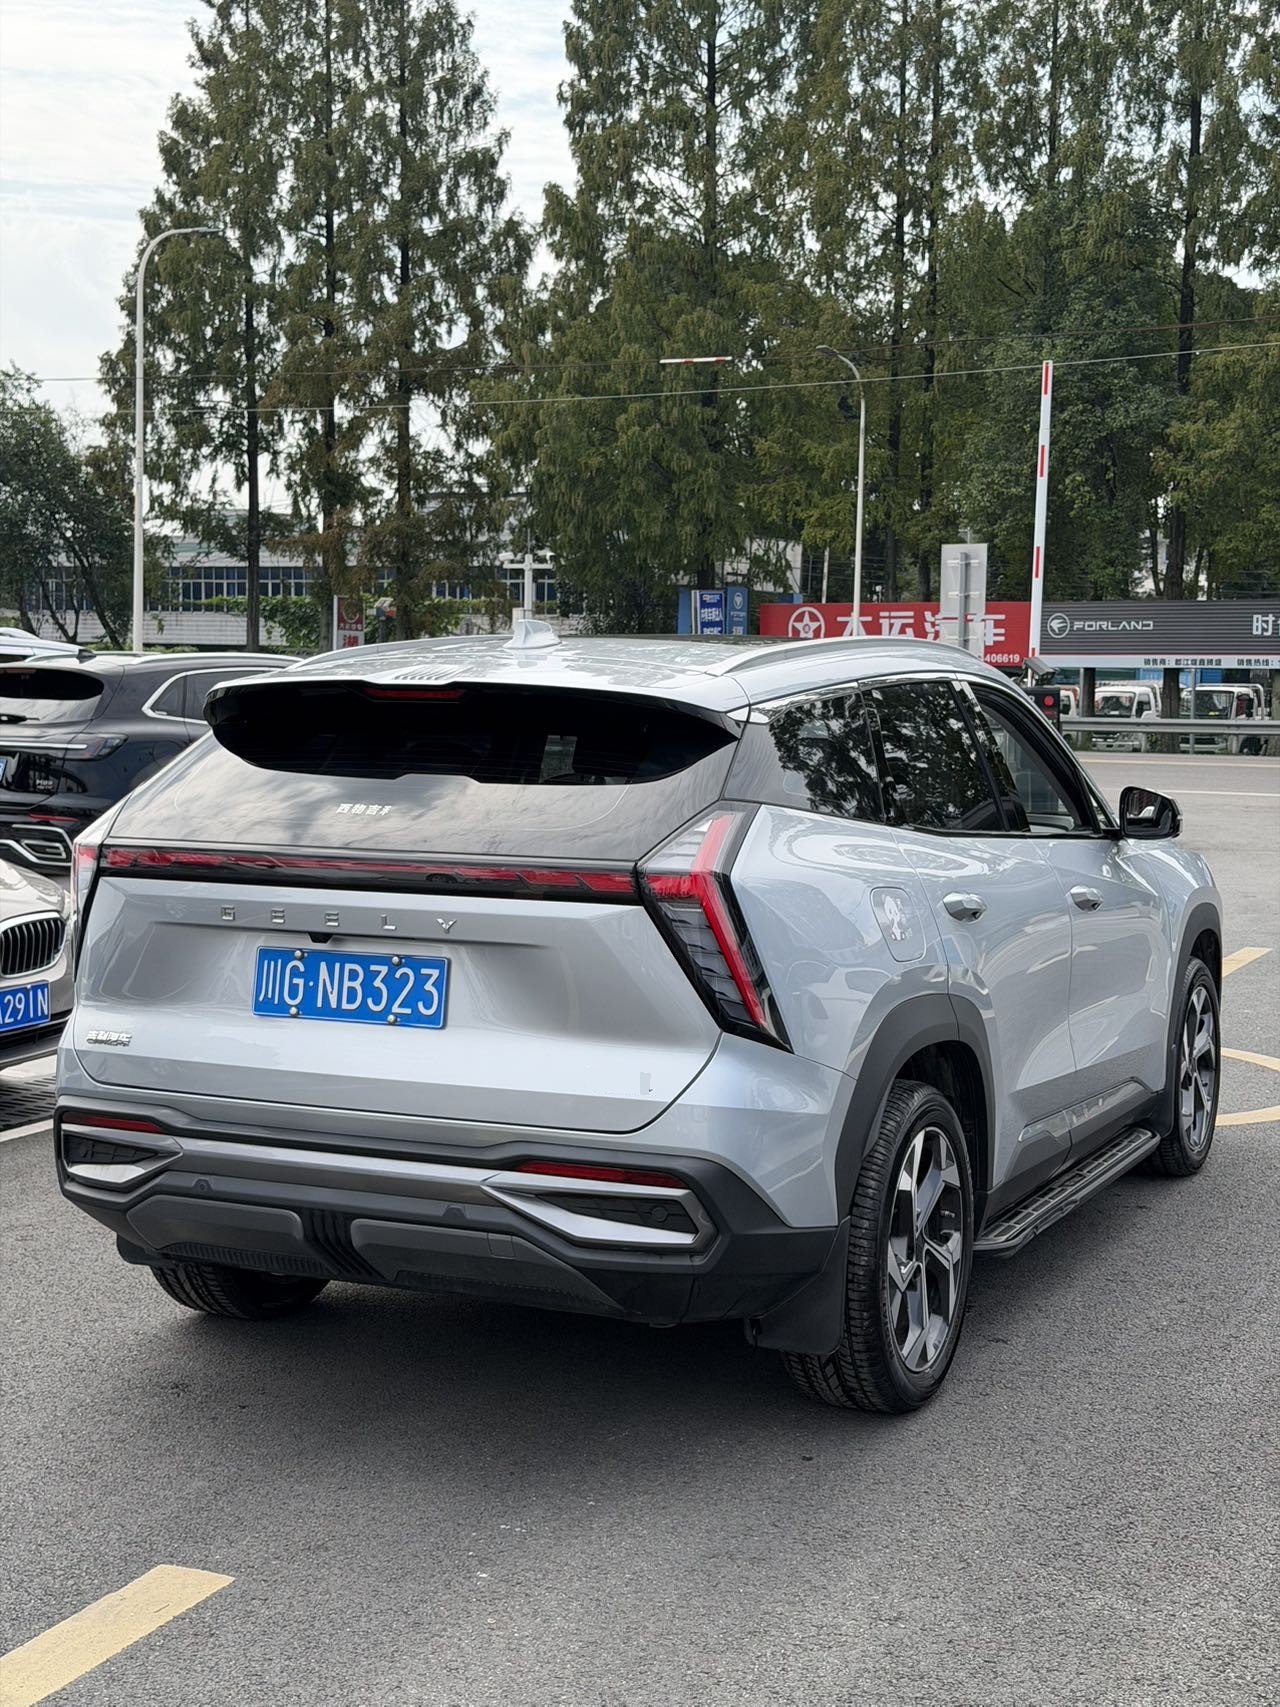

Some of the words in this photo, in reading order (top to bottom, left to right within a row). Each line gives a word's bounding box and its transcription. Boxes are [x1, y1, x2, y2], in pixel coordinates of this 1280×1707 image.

[1073, 620, 1154, 631] FORLAND
[1252, 613, 1280, 636] 时
[220, 904, 457, 934] GEELY
[0, 988, 48, 1024] 291N
